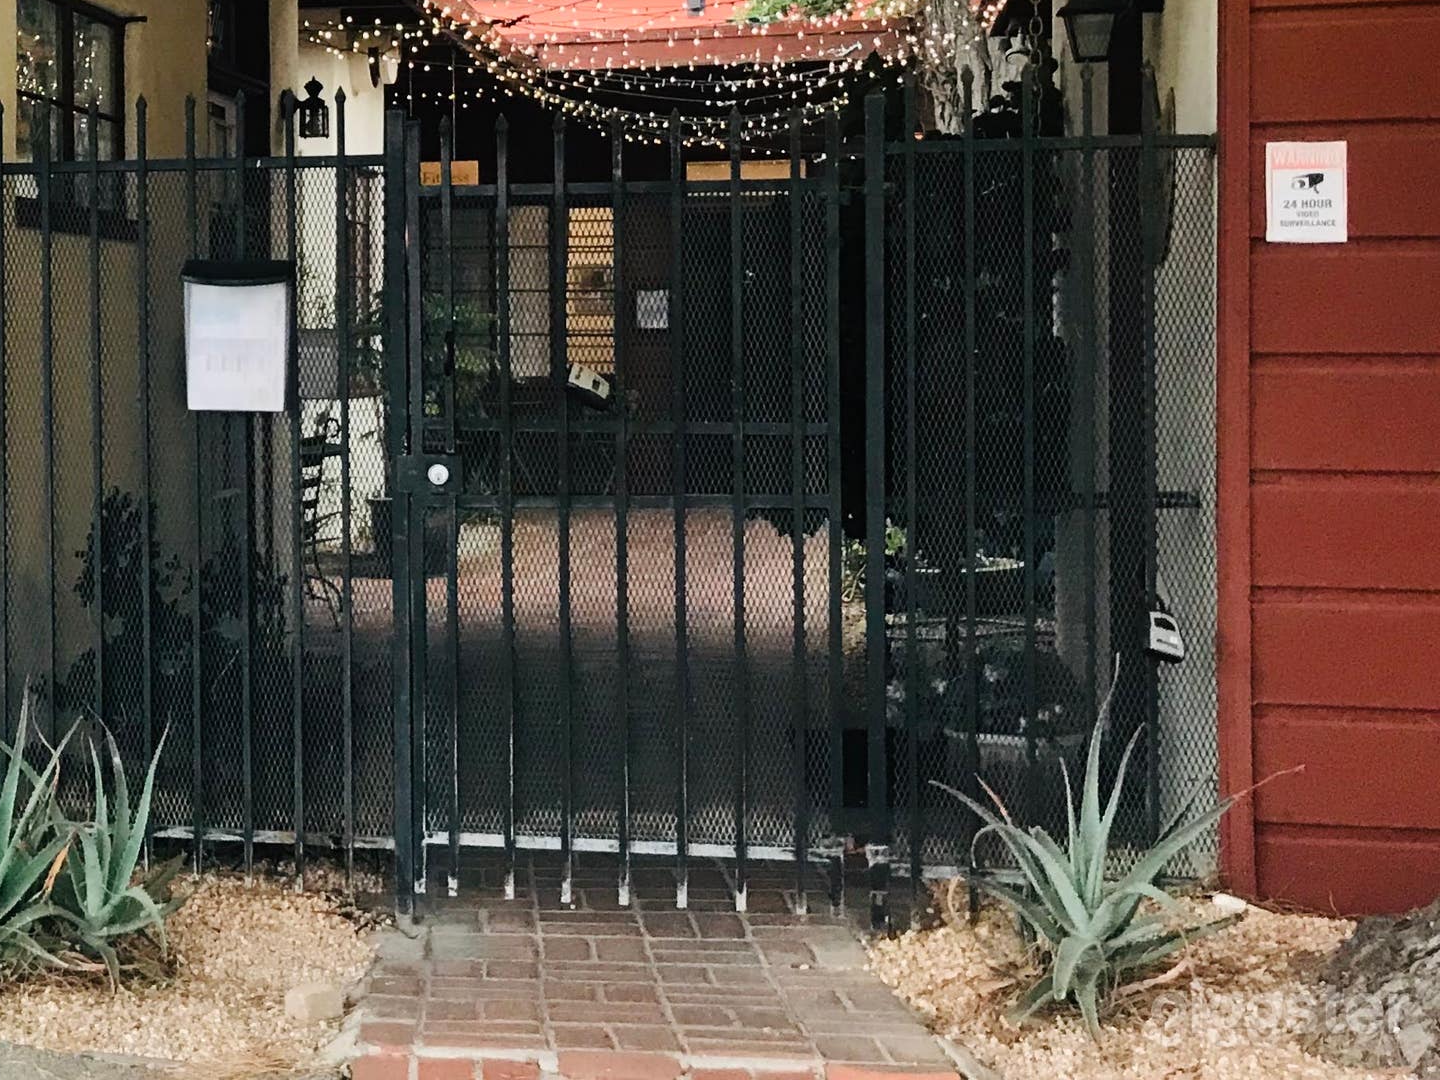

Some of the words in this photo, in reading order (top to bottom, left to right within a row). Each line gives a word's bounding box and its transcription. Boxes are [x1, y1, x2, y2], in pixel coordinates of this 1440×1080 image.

[1283, 200, 1298, 209] 24
[1301, 199, 1333, 209] HOUR
[1280, 219, 1337, 227] SURVEILLANCE
